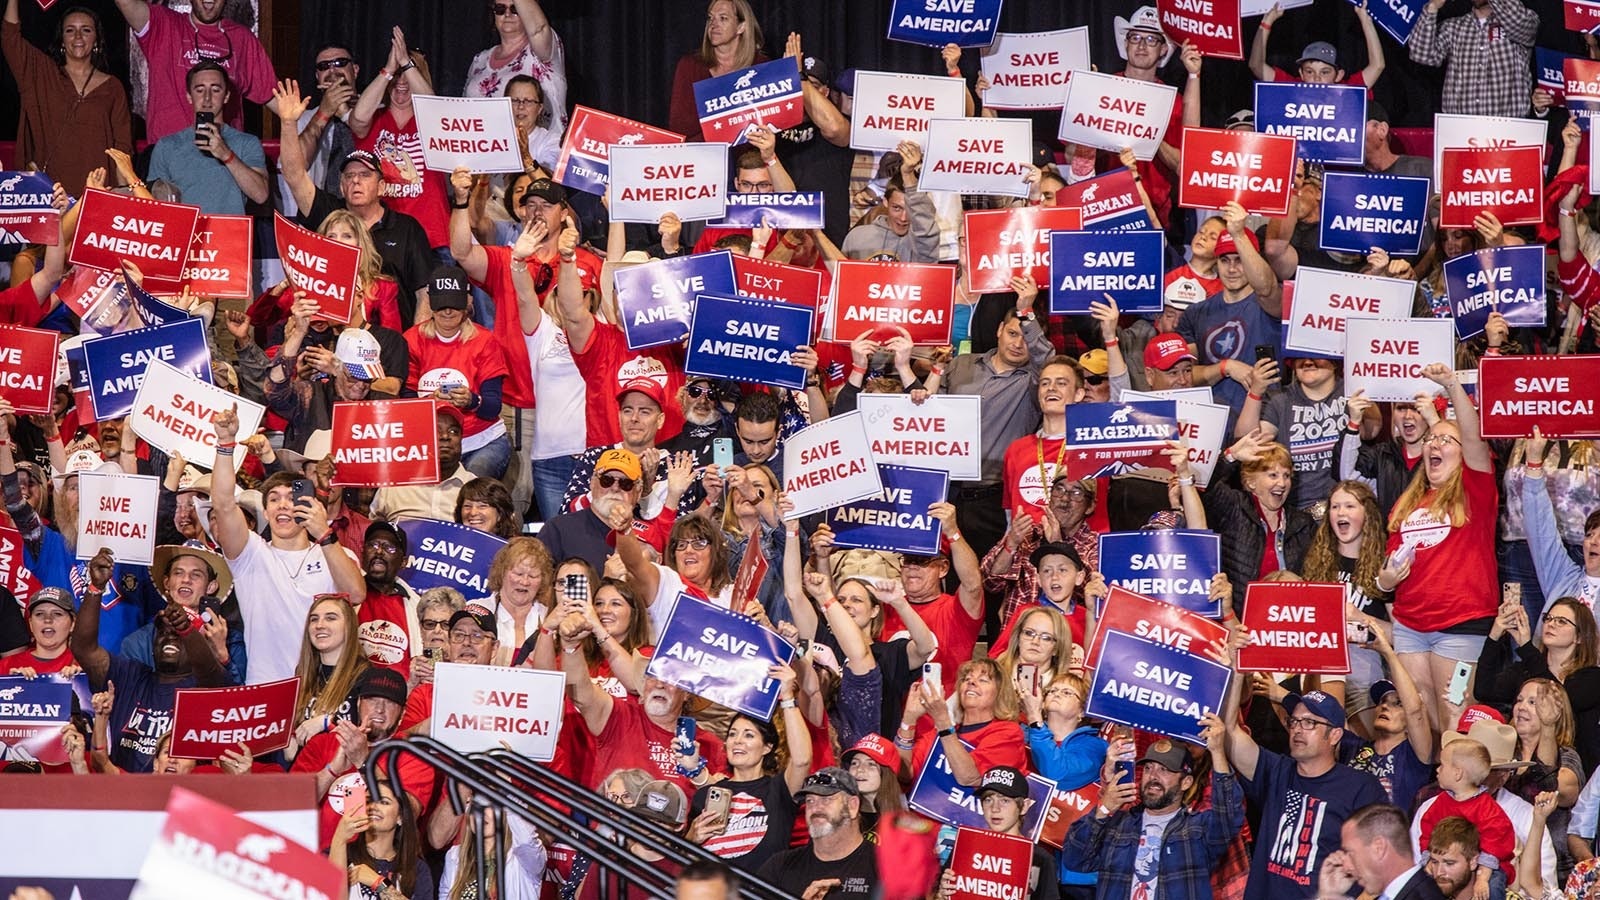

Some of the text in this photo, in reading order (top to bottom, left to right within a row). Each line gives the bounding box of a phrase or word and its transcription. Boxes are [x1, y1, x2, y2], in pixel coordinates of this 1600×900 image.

[924, 0, 974, 13] SAVE
[1174, 0, 1213, 16] SAVE
[900, 15, 990, 34] AMERICA!
[1163, 14, 1233, 38] AMERICA!
[1011, 52, 1059, 66] SAVE
[704, 78, 793, 113] HAGEMAN
[888, 94, 935, 111] SAVE
[1099, 96, 1146, 116] SAVE
[1285, 103, 1335, 119] SAVE
[441, 118, 483, 132] SAVE
[728, 116, 743, 126] FOR
[864, 115, 928, 132] AMERI
[1073, 113, 1158, 140] AMERICA!
[429, 137, 509, 152] AMERICA!
[958, 140, 1004, 153] SAVE
[933, 160, 1022, 176] AMERICA!
[1211, 150, 1262, 169] SAVE
[572, 166, 592, 179] TEXT
[644, 165, 695, 180] SAVE
[1463, 168, 1512, 184] SAVE
[1189, 171, 1282, 193] AMERICA!
[0, 194, 52, 206] EMAN
[620, 184, 717, 202] AMERICA!
[1446, 189, 1534, 206] AMERICA!
[1083, 194, 1134, 217] EMAN
[1355, 194, 1403, 212] SAVE
[111, 216, 164, 237] SAVE
[1330, 216, 1418, 234] AMERICA!
[83, 232, 181, 261] AMERICA!
[1000, 230, 1050, 246] SAVE
[189, 250, 218, 262] LLY
[288, 244, 328, 274] SAVE
[978, 252, 1050, 270] AMERIC
[1084, 252, 1134, 267] SAVE
[436, 278, 460, 290] USA
[744, 273, 783, 291] TEXT
[1061, 275, 1156, 291] AMERICA!
[1466, 267, 1512, 288] SAVE
[868, 284, 922, 301] SAVE
[1329, 294, 1380, 313] SAVE
[1457, 288, 1535, 317] AMERICA!
[845, 306, 944, 324] AMERICA!
[726, 320, 780, 341] SAVE
[0, 348, 22, 364] VE
[698, 338, 794, 366] AMERICA
[1370, 340, 1419, 354] SAVE
[121, 345, 175, 368] SAVE
[1352, 362, 1425, 378] AMERIC
[0, 375, 43, 391] ICA!
[1514, 378, 1569, 393] SAVE
[1292, 400, 1349, 423] TRUMP
[1491, 400, 1594, 416] AMERICA!
[142, 404, 218, 447] AMERIC
[352, 423, 403, 440] SAVE
[893, 417, 945, 432] SAVE
[1075, 425, 1170, 441] HAGEMAN
[1179, 423, 1199, 438] VE
[1290, 416, 1350, 442] 2020
[336, 446, 429, 464] AMERICA!
[800, 441, 842, 466] SAVE
[872, 440, 969, 456] AMERICA!
[1096, 448, 1153, 459] FOR WYOMING
[786, 458, 867, 494] AMERICA!
[1294, 462, 1318, 472] CRY
[100, 496, 131, 513] SAVE
[834, 508, 933, 531] AMERICA!
[85, 522, 147, 539] AMERICA!
[420, 537, 475, 564] SAVE
[1130, 554, 1186, 571] SAVE
[405, 555, 488, 594] MERICA!
[14, 566, 31, 610] SAV
[1268, 605, 1316, 623] SAVE
[360, 628, 405, 643] HAGEMAN
[700, 626, 760, 660] SAVE
[1134, 620, 1192, 650] SAVE
[1250, 630, 1338, 650] AMERICA!
[1134, 661, 1192, 690] SAVE
[474, 690, 528, 709] SAVE
[1102, 680, 1210, 721] AMERICA!
[0, 704, 61, 717] EMAN
[210, 704, 267, 723] SAVE
[182, 720, 287, 744] AMERICA!
[444, 713, 549, 736] AMERICA!
[1002, 769, 1015, 778] GO
[1295, 796, 1321, 874] TRUMP
[972, 852, 1012, 874] SAVE
[956, 874, 1024, 900] AMERICA!
